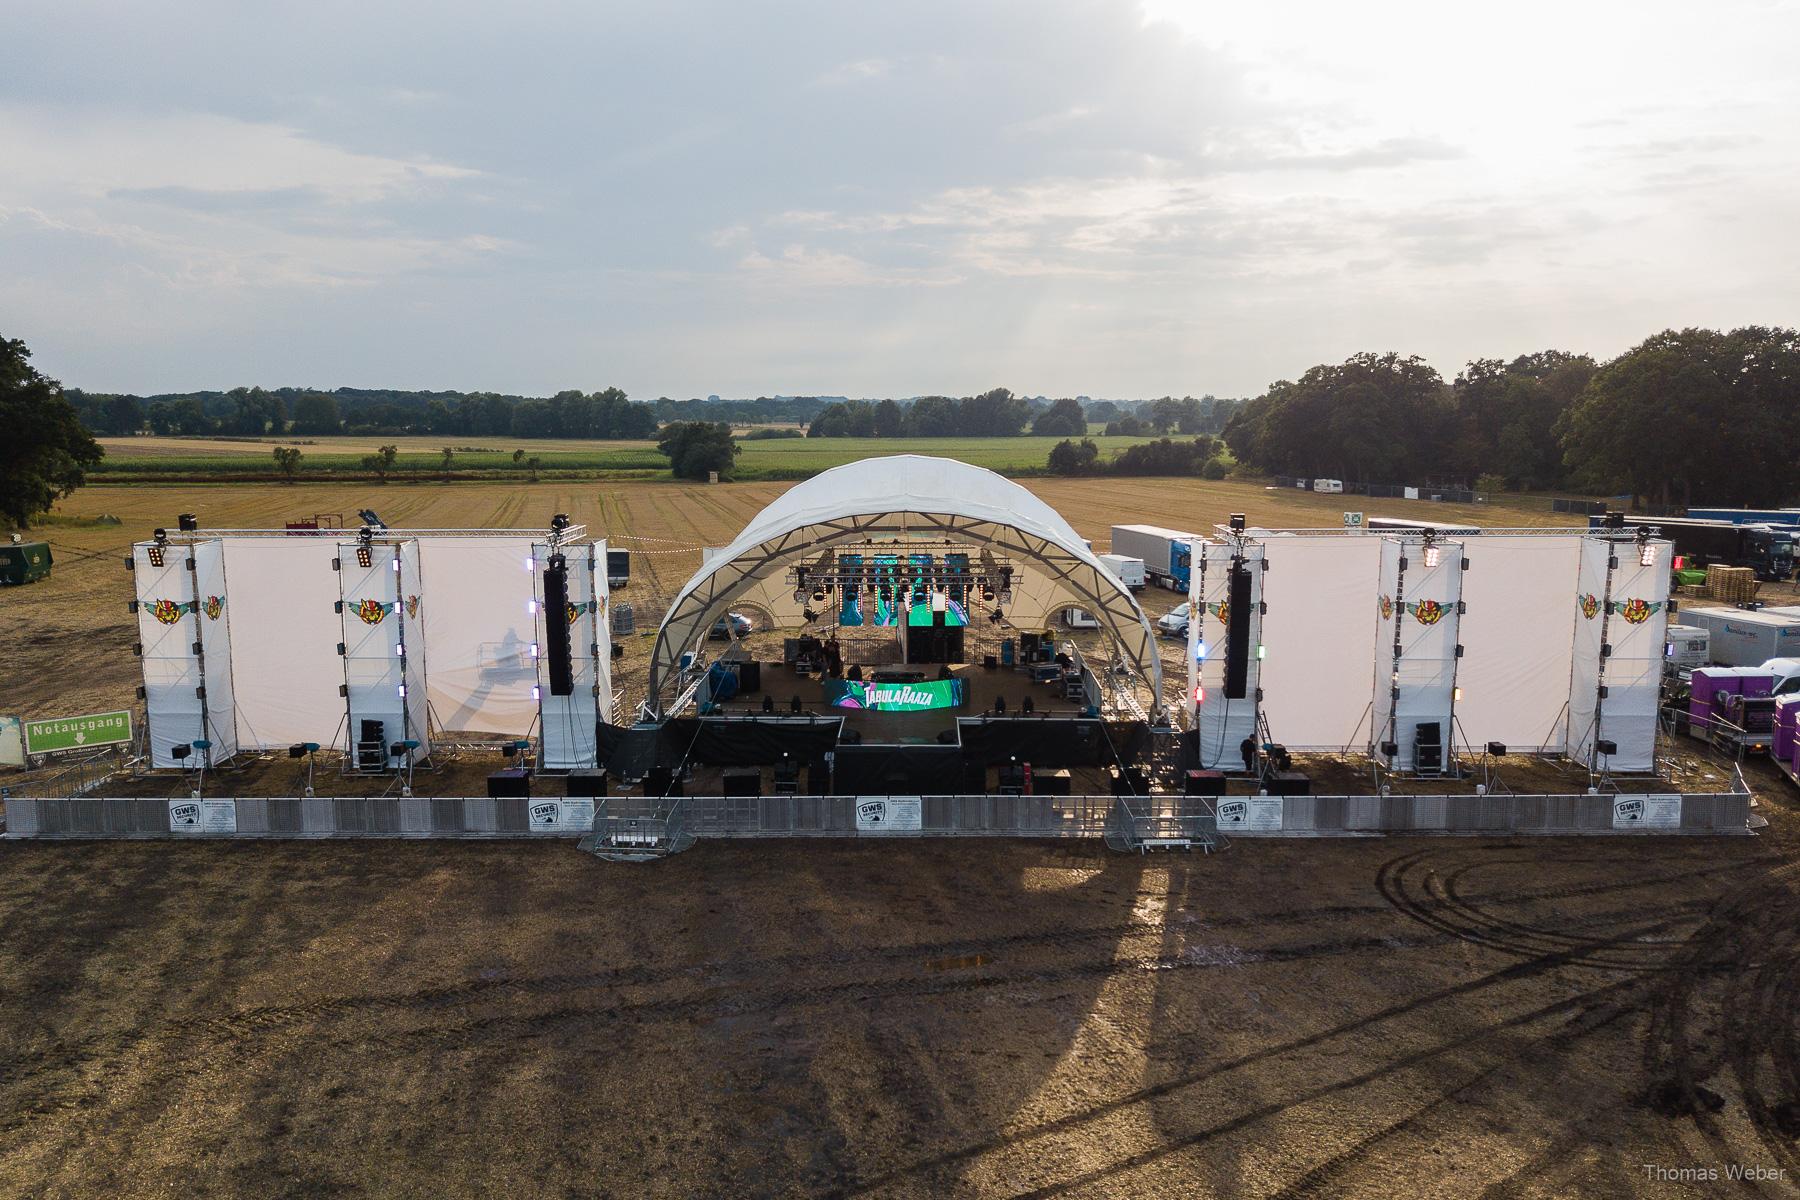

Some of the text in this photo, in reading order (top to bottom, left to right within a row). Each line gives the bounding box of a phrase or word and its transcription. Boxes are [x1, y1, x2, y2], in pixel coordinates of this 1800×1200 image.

[33, 717, 123, 736] Notausgang
[175, 806, 196, 816] GWS
[534, 805, 555, 815] GWS
[861, 803, 882, 813] GWS
[1222, 804, 1244, 813] GWS
[1619, 802, 1641, 811] GWS
